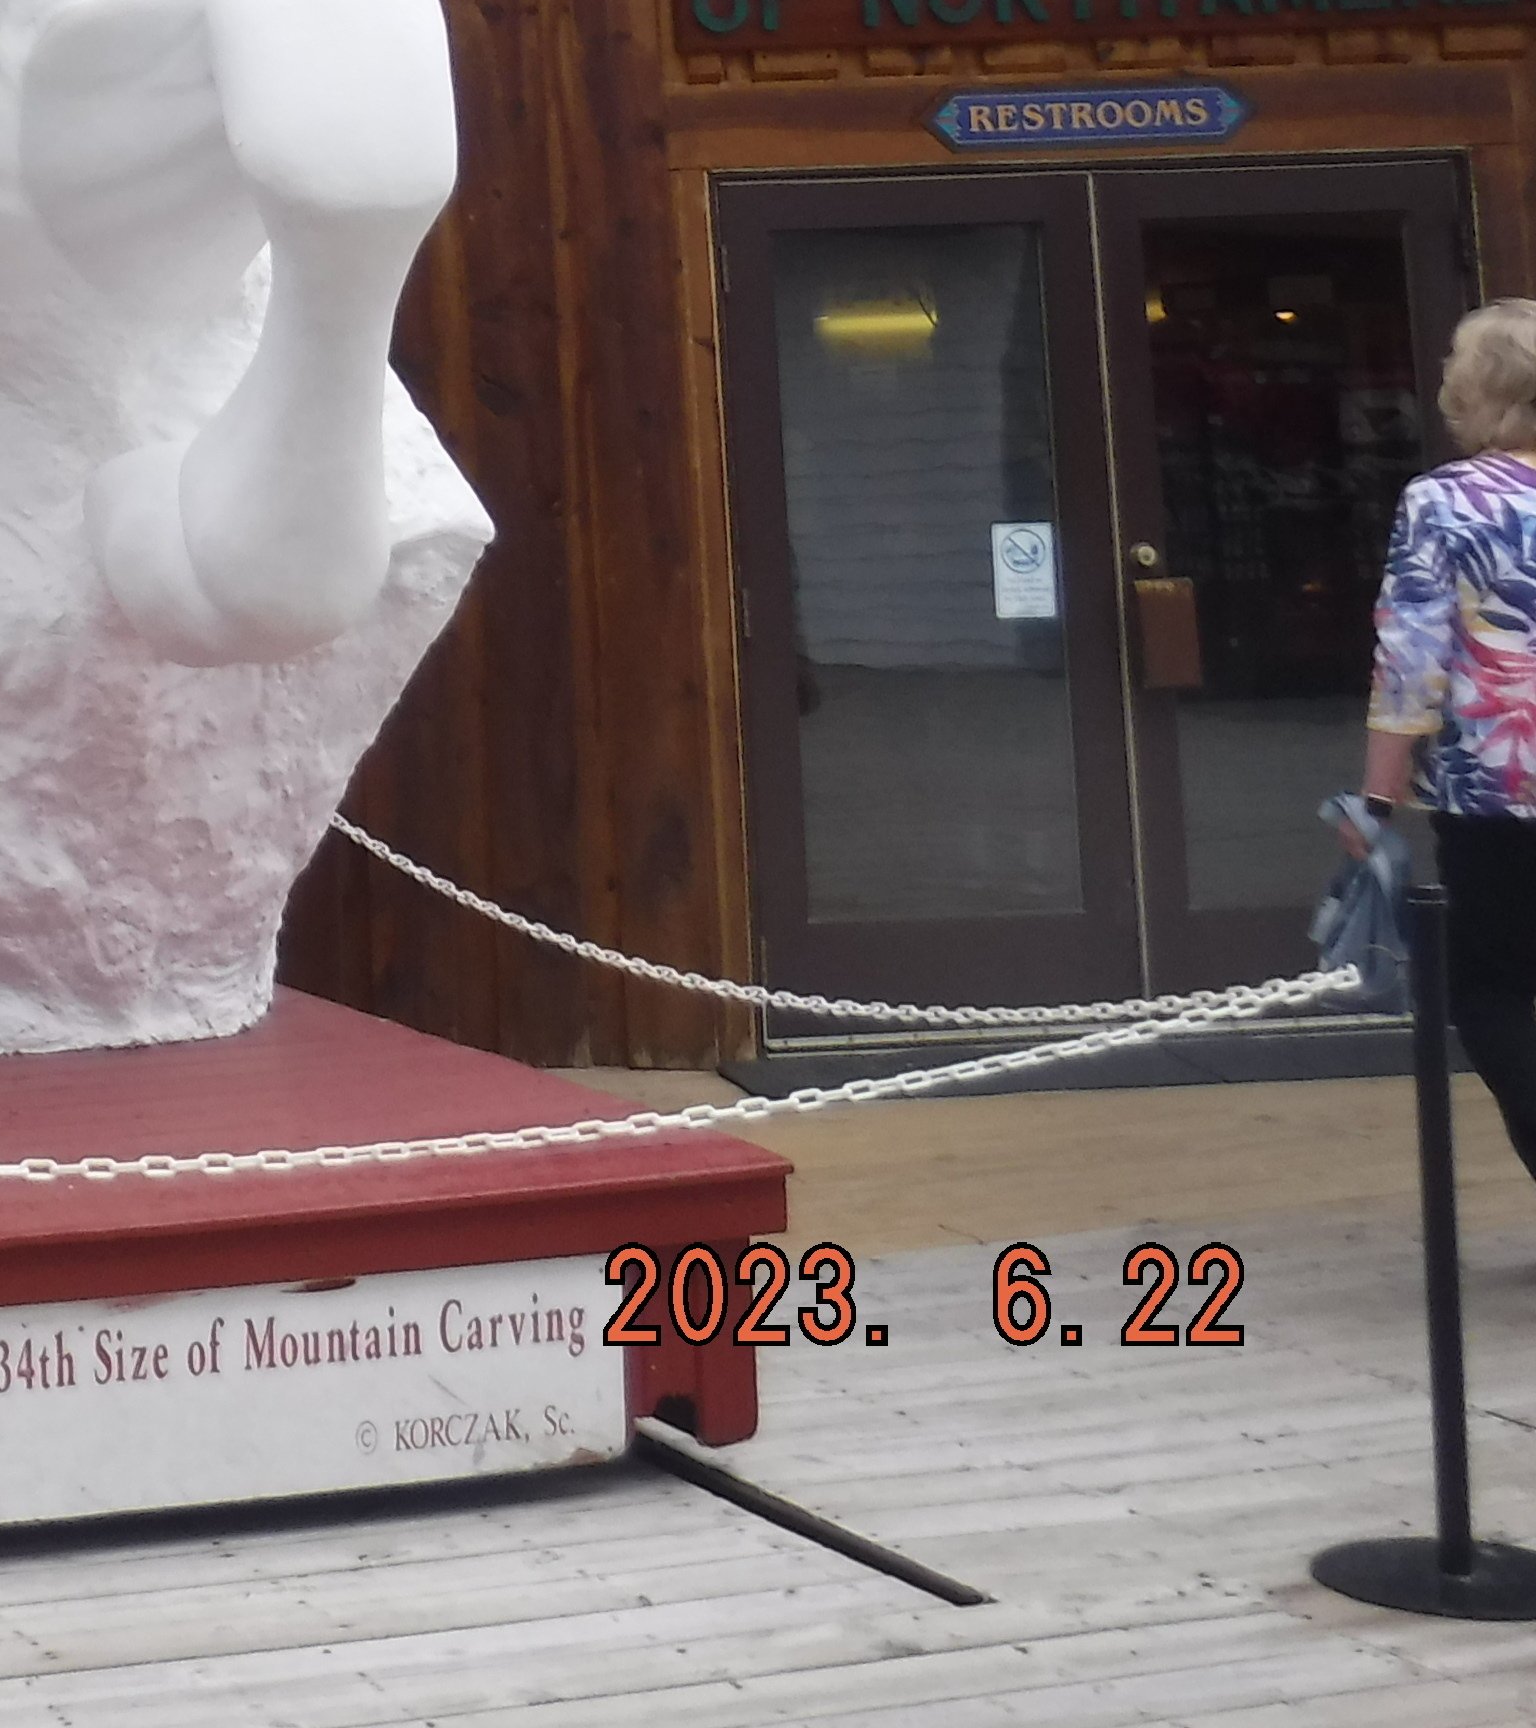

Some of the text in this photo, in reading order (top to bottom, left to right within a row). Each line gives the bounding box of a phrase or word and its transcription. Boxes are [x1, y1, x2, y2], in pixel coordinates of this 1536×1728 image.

[967, 95, 1209, 134] RESTROOMS
[93, 1326, 170, 1387] Size
[186, 1316, 226, 1376] of
[243, 1305, 423, 1371] Mountain
[438, 1292, 586, 1358] Carving
[393, 1407, 531, 1453] KORCZAK,
[542, 1403, 576, 1439] Sc.
